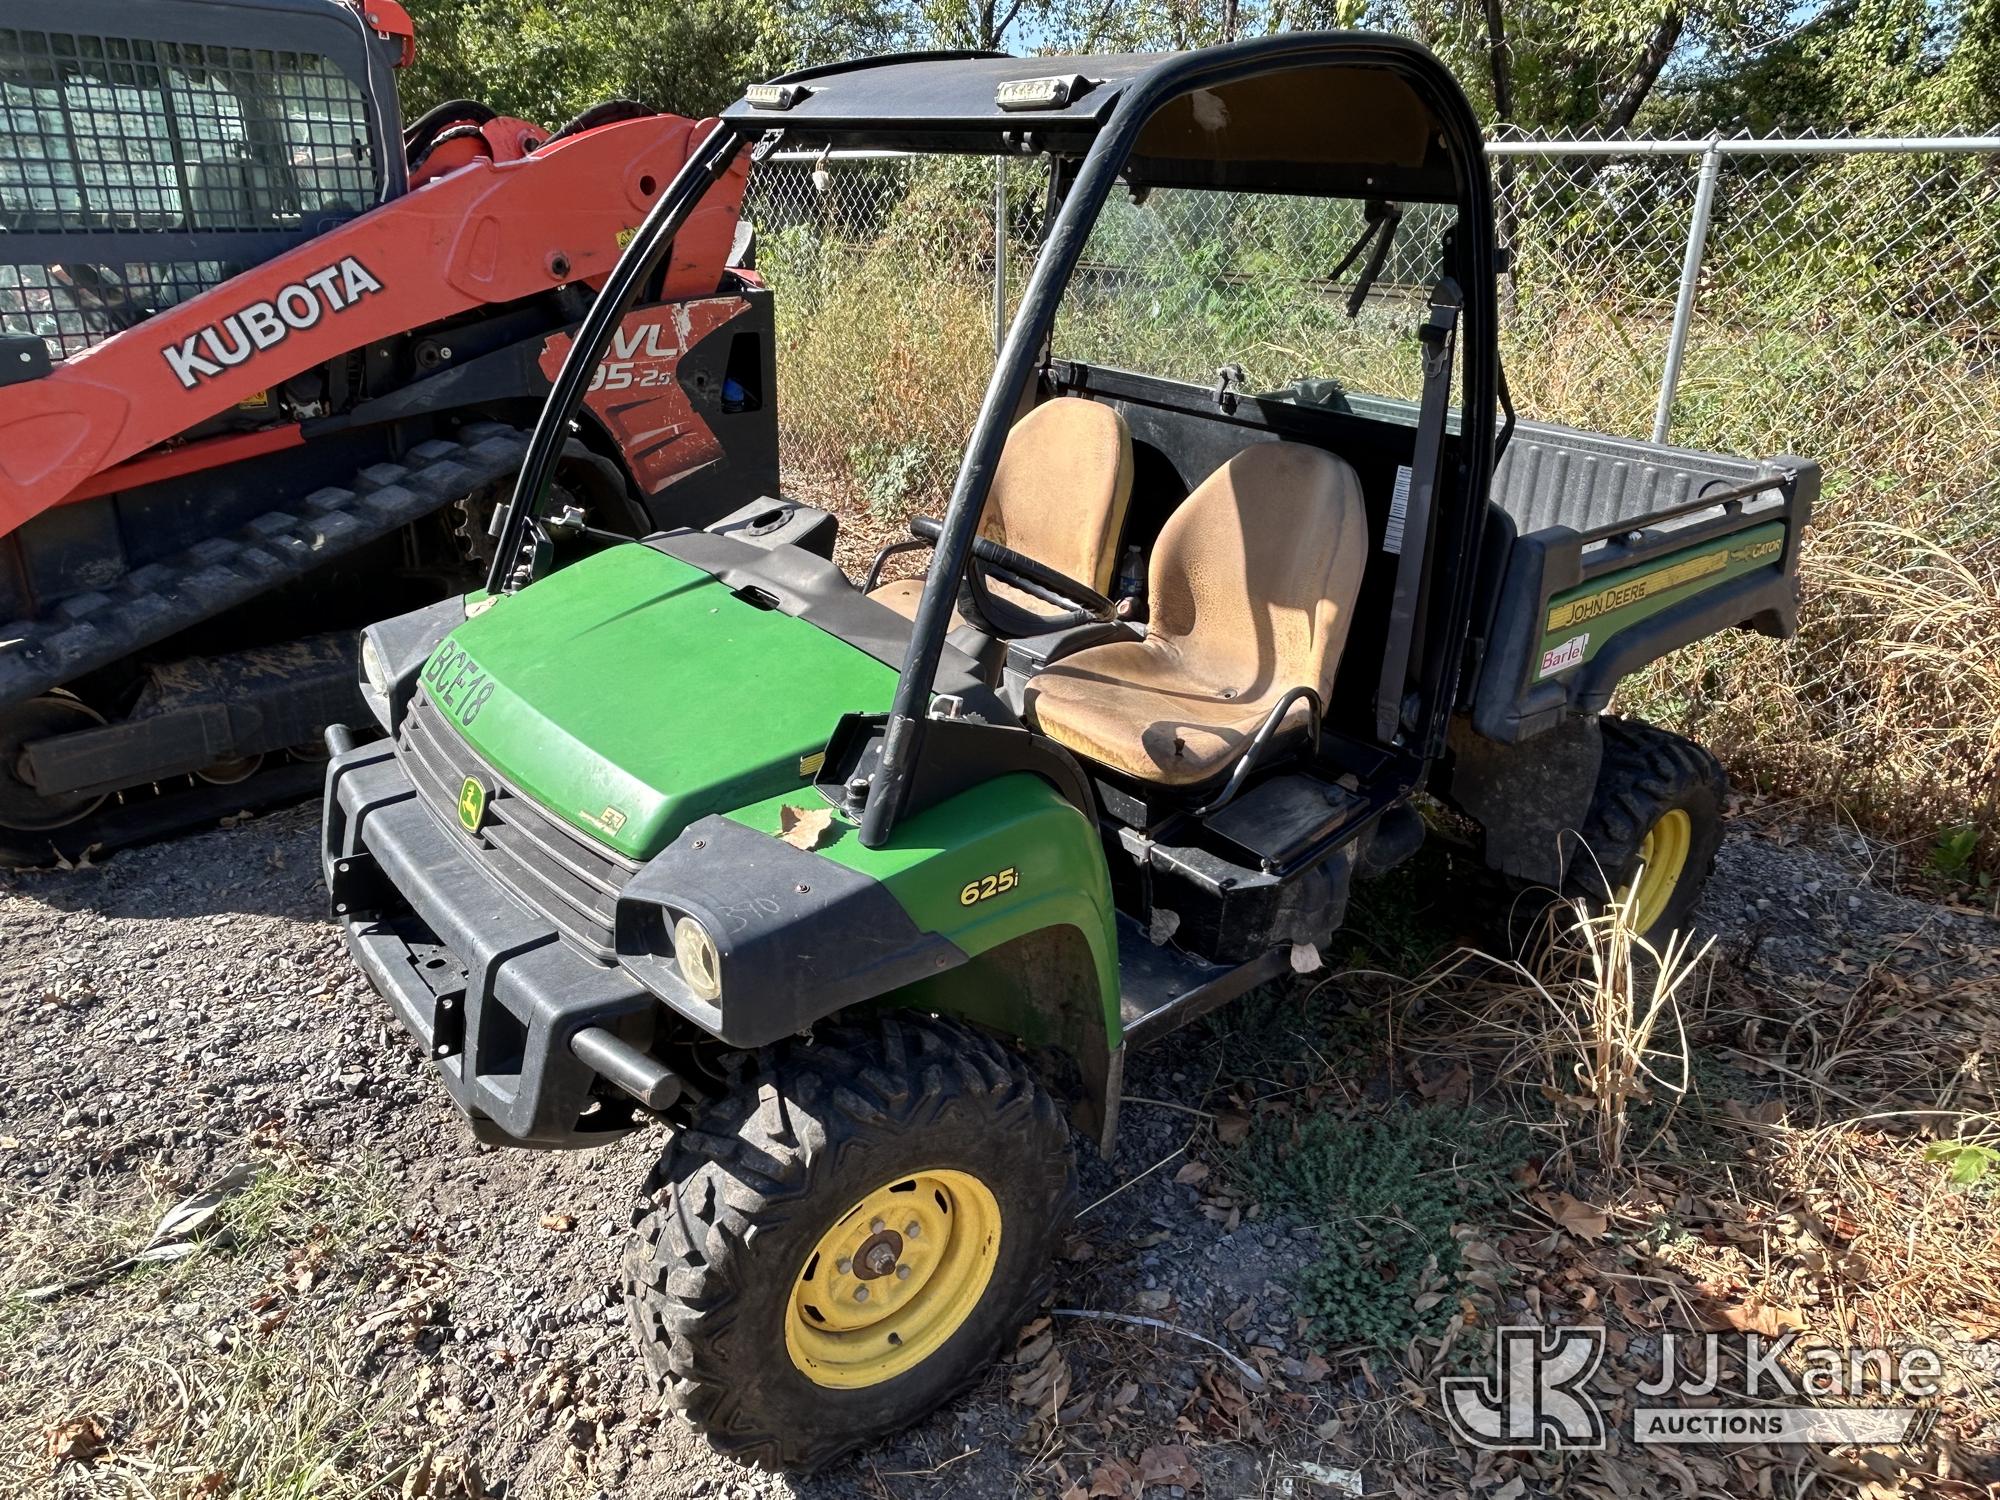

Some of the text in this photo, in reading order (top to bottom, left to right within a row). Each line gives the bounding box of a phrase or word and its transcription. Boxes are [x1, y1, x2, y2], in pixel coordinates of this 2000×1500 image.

[161, 256, 383, 389] KUBOTA
[601, 323, 678, 360] VL
[1565, 582, 1647, 625] JOHN DEERE
[425, 640, 495, 726] BCE18
[960, 867, 1019, 906] 625i
